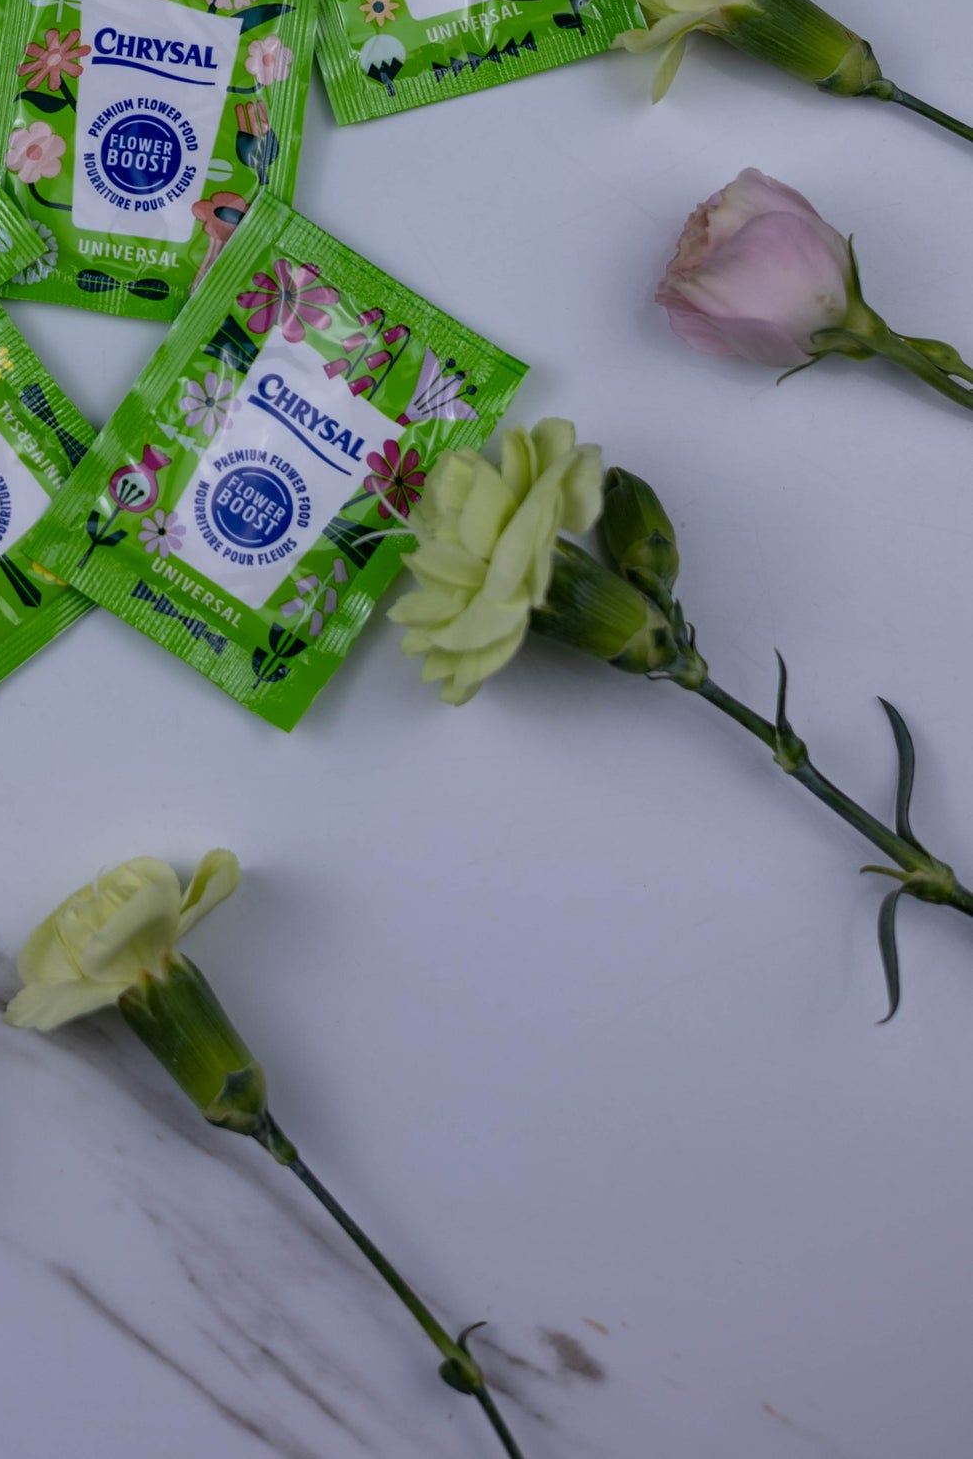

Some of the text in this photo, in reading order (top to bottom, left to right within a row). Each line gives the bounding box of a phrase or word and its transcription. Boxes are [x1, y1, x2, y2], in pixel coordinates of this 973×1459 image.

[426, 2, 523, 43] UNIVERSAL
[94, 27, 218, 69] CHRYSAL
[88, 98, 198, 151] PREMIUM FLOWER FOOD
[110, 134, 173, 156] FLOWER
[84, 153, 197, 212] NOURRITURE POUR FLEURS
[106, 149, 171, 174] BOOST
[79, 239, 179, 267] UNIVERSAL
[258, 373, 365, 462] CHRYSAL
[213, 449, 310, 528] PREMIUM FLOWER FOOD
[216, 488, 278, 536] BOOST
[227, 476, 286, 522] FLOWER
[194, 480, 298, 566] NOURRITURE POUR FLEURS
[151, 557, 243, 628] UNIVERSAL
